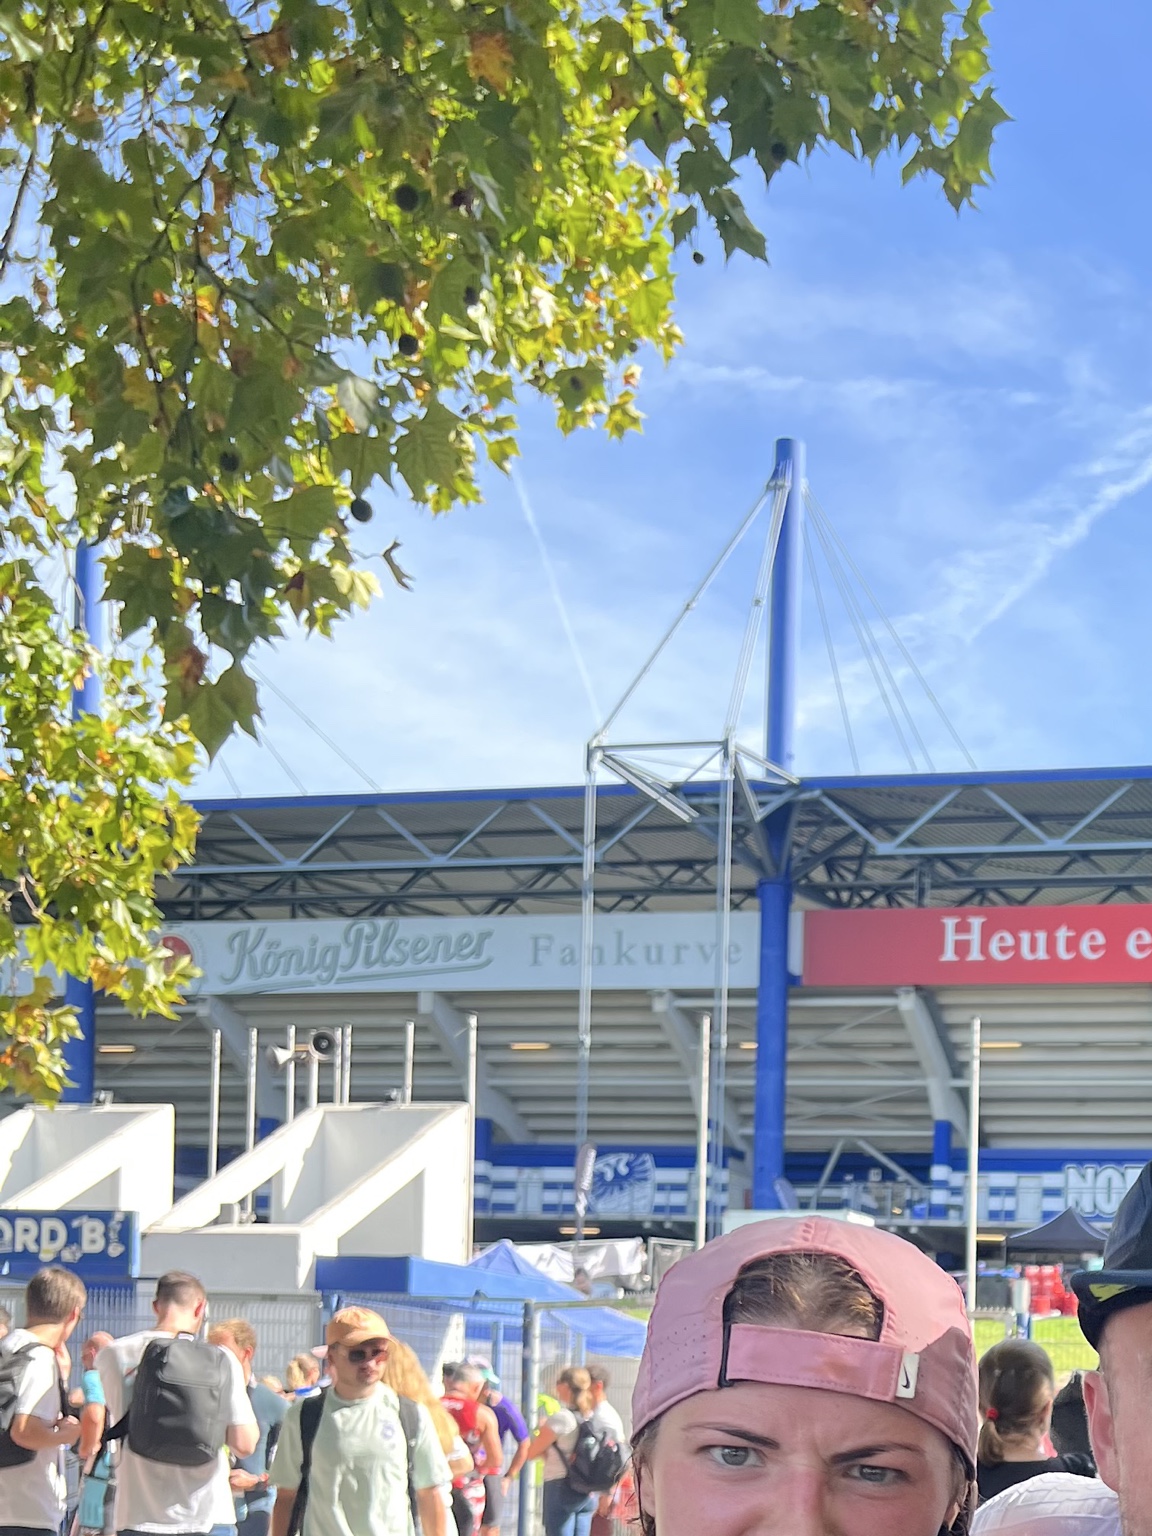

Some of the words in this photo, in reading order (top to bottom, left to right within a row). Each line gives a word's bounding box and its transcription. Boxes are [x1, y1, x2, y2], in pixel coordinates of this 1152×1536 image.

[219, 927, 342, 985] König
[340, 919, 494, 972] Pilsener
[939, 916, 1106, 962] Heute
